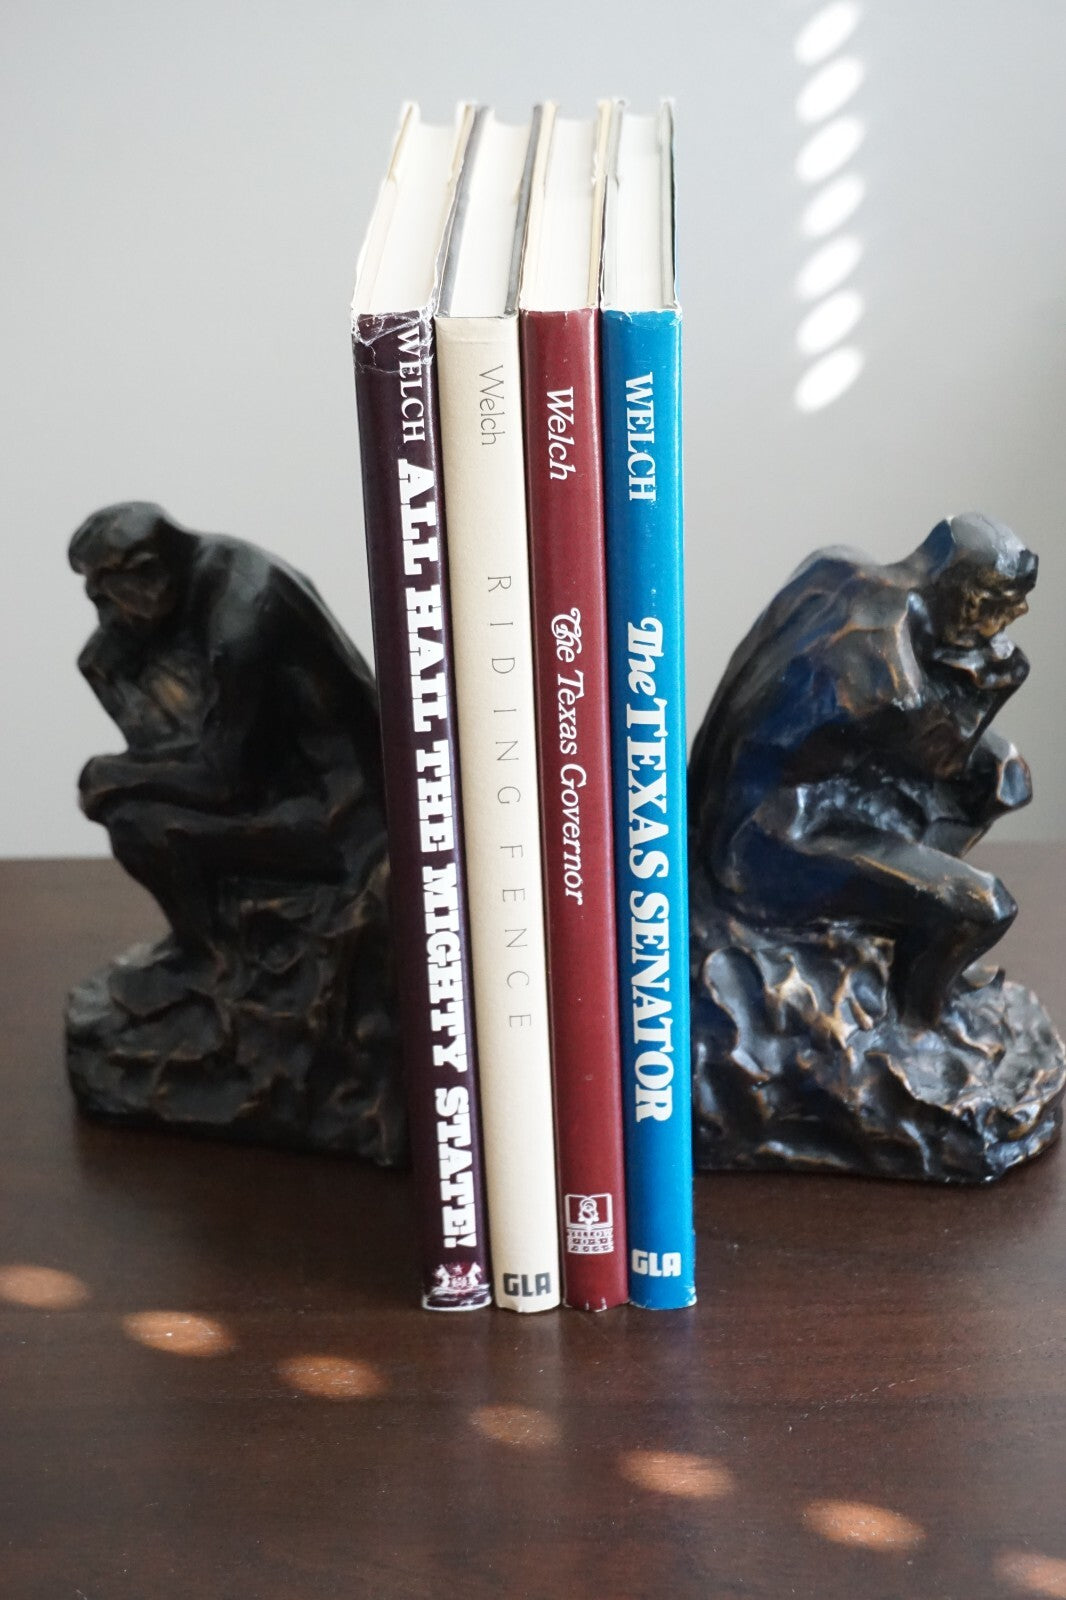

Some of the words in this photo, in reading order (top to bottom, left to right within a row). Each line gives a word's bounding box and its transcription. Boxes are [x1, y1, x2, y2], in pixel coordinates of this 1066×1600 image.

[397, 326, 425, 444] WELCH
[478, 364, 506, 446] Welch
[546, 386, 577, 481] Welch
[625, 371, 657, 502] WELCH
[397, 457, 439, 575] ALL
[404, 584, 449, 732] HAIL
[550, 607, 583, 663] The
[626, 616, 665, 696] The
[556, 669, 585, 756] Texas
[416, 739, 454, 852] THE
[559, 763, 588, 906] Governor
[626, 697, 669, 879] TEXAS
[421, 862, 468, 1073] MIGHTY
[629, 890, 674, 1123] SENATOR
[434, 1085, 478, 1248] STATE!
